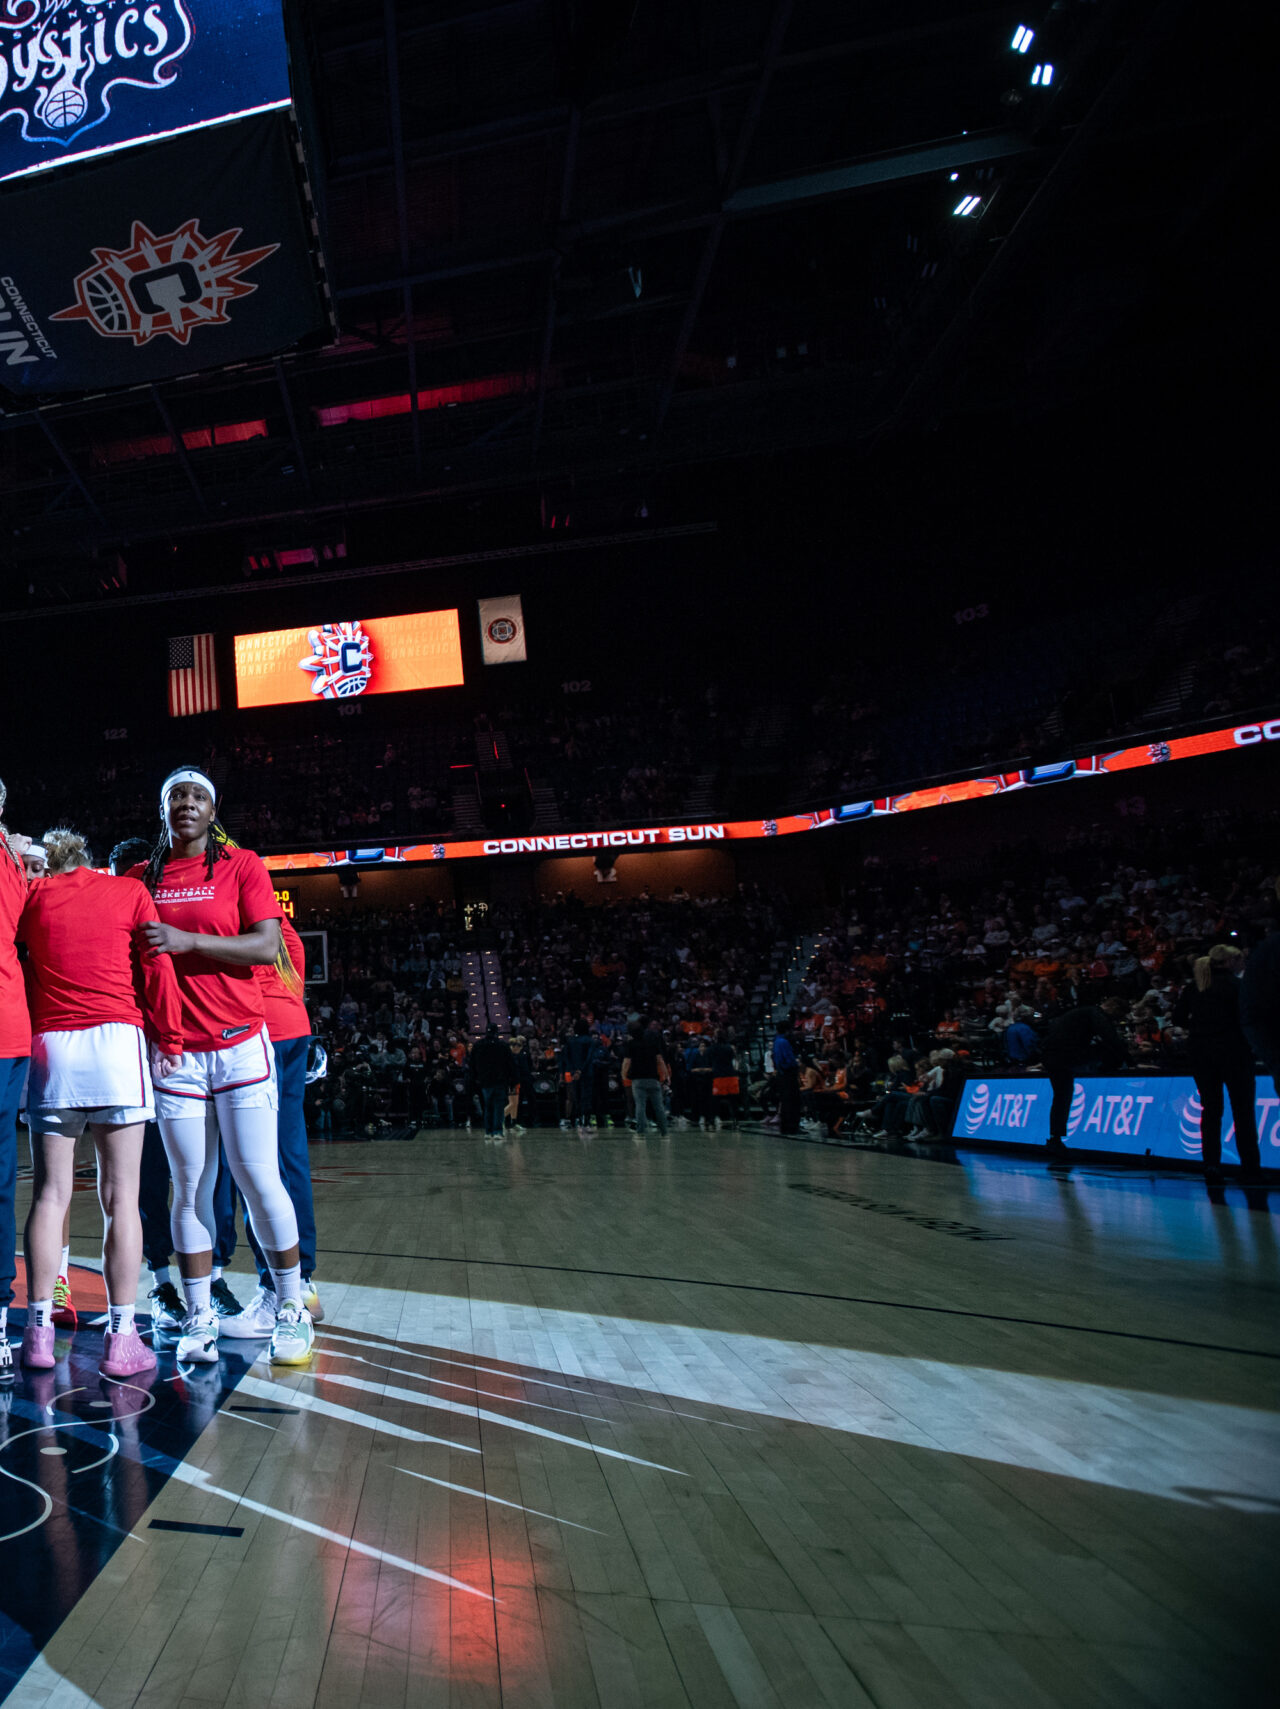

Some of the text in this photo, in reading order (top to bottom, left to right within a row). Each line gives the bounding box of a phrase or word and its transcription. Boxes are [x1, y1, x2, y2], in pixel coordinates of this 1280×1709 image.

[0, 276, 58, 360] CONNECTICUT
[952, 603, 989, 624] 103
[560, 680, 592, 694] 102
[337, 702, 362, 716] 101
[104, 728, 128, 740] 122
[483, 824, 726, 855] CONNECTICUT SUN
[593, 867, 617, 882] 12
[987, 1094, 1038, 1127] AT&T
[1083, 1095, 1154, 1136] AT&T
